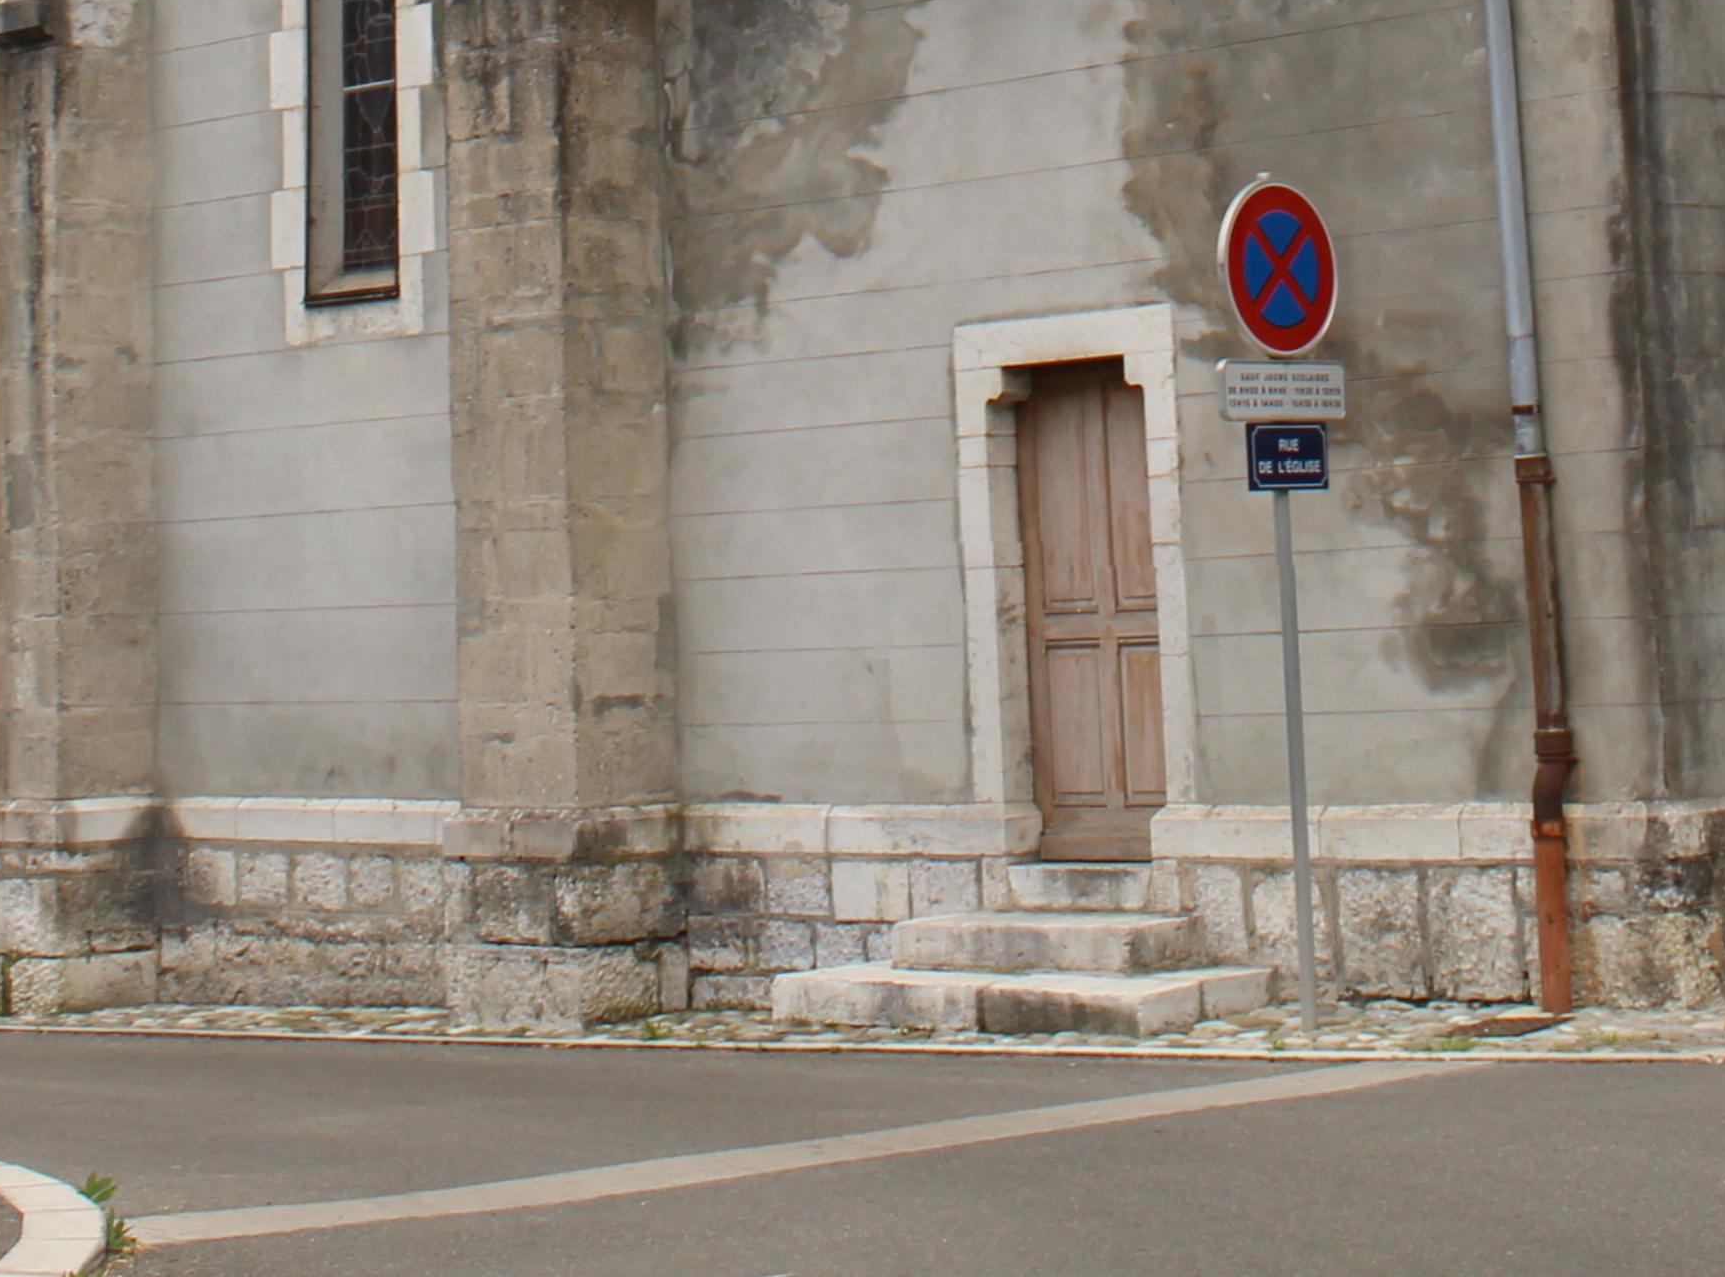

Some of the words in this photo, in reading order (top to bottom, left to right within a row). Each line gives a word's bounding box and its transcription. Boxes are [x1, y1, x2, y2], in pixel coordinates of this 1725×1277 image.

[1240, 372, 1259, 382] SAUF
[1264, 372, 1288, 382] JOURS
[1292, 372, 1329, 382] SCOLAIRES
[1278, 438, 1300, 452] RUE
[1258, 460, 1273, 474] DE
[1278, 457, 1322, 473] L'ÉGLISE
